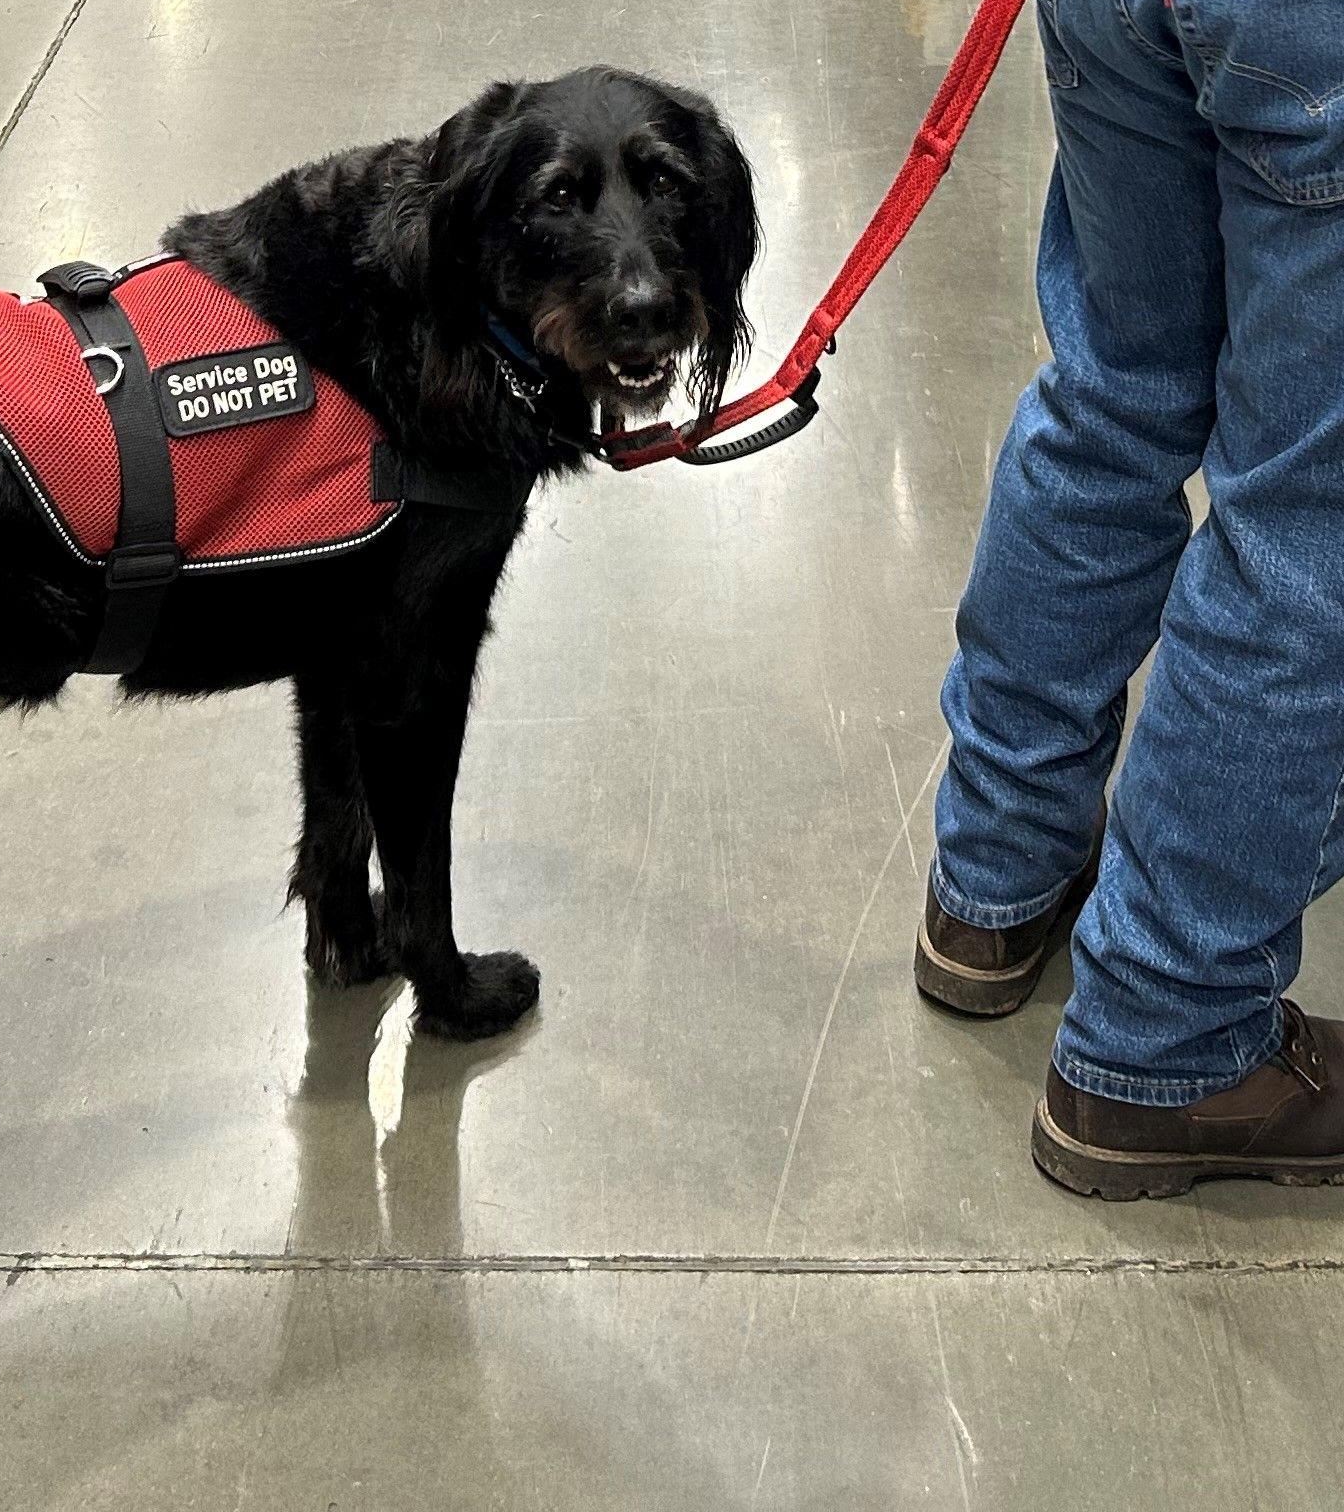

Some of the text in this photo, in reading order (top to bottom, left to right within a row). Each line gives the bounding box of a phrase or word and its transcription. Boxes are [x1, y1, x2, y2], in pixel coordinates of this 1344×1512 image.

[167, 354, 297, 396] Service Dog
[178, 377, 298, 422] DO NOT PET
